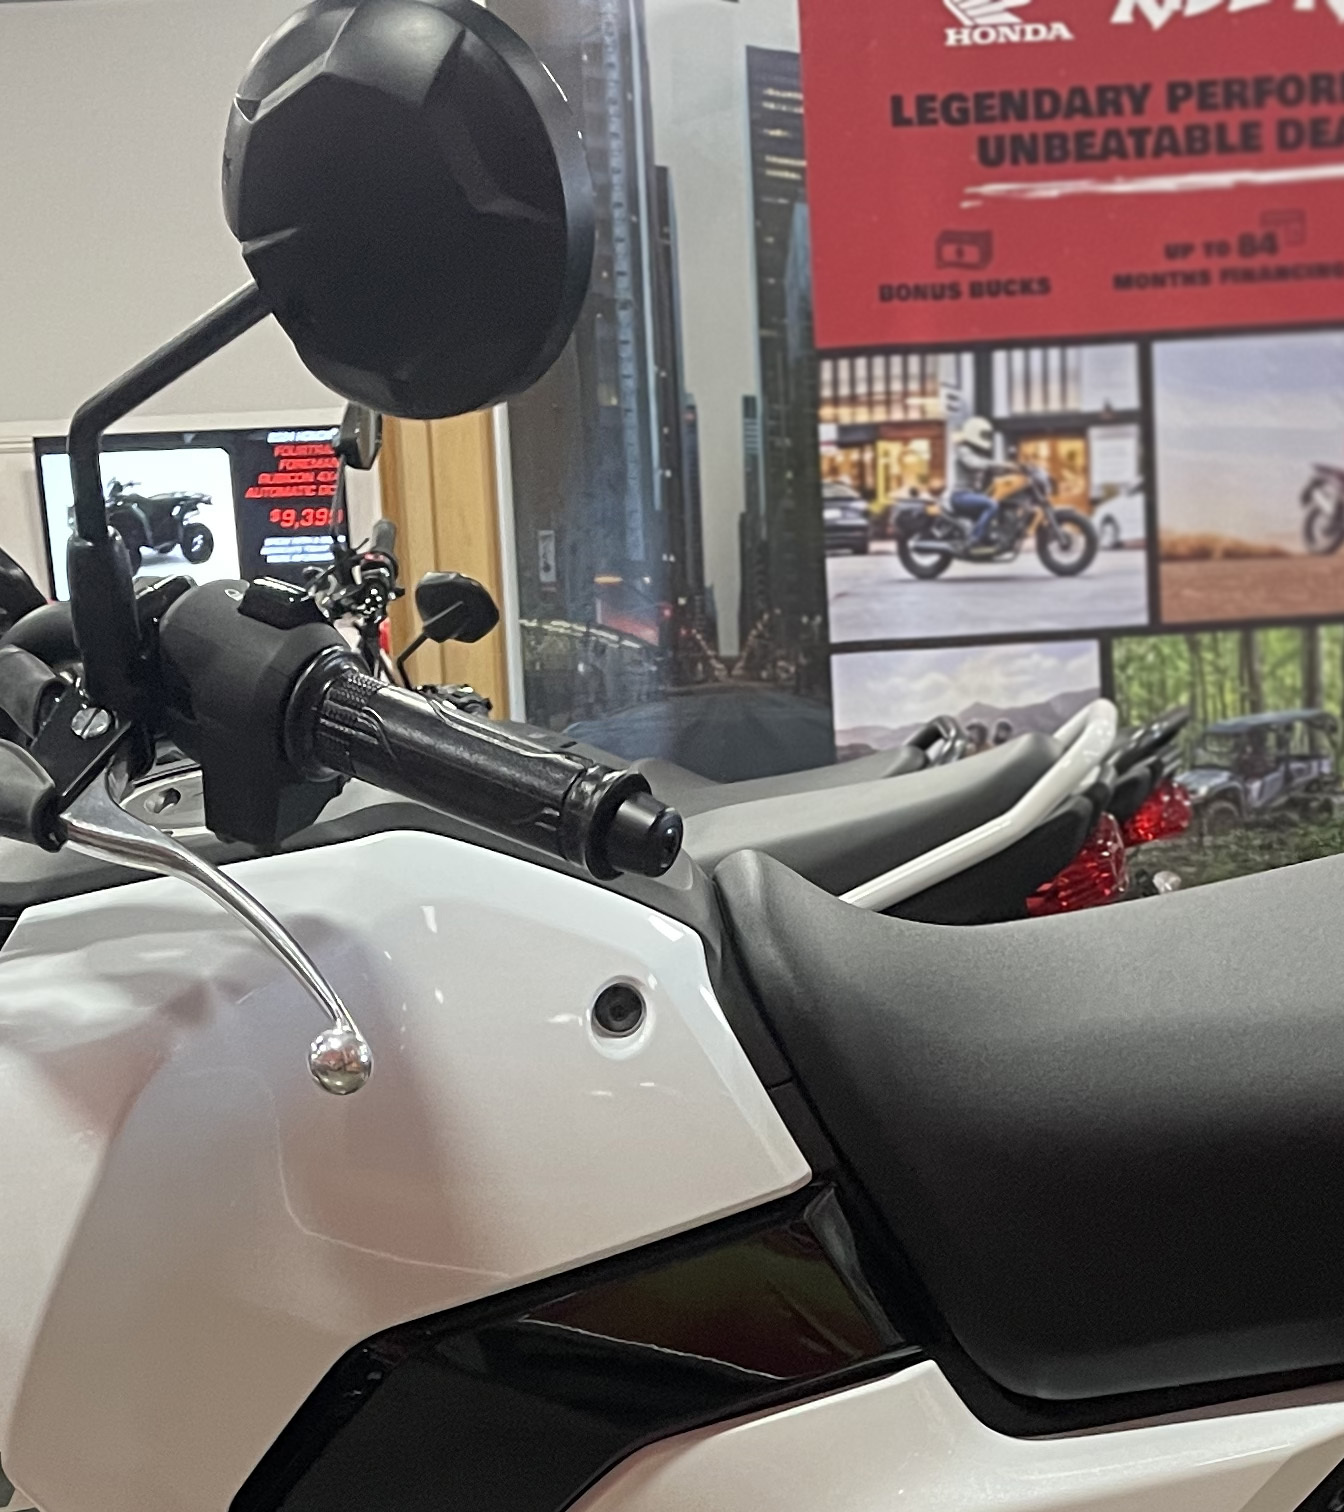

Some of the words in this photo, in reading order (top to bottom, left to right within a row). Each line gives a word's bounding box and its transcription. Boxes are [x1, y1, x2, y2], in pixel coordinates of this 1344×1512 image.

[944, 22, 1075, 47] HONDA
[889, 82, 1152, 128] LEGENDARY
[976, 120, 1264, 168] UNBEATABLE
[1164, 243, 1195, 260] UP
[1203, 240, 1232, 257] TO
[1237, 231, 1279, 258] 84
[878, 282, 963, 303] BONUS
[969, 276, 1052, 299] BUCKS
[1112, 268, 1211, 292] MONTHS
